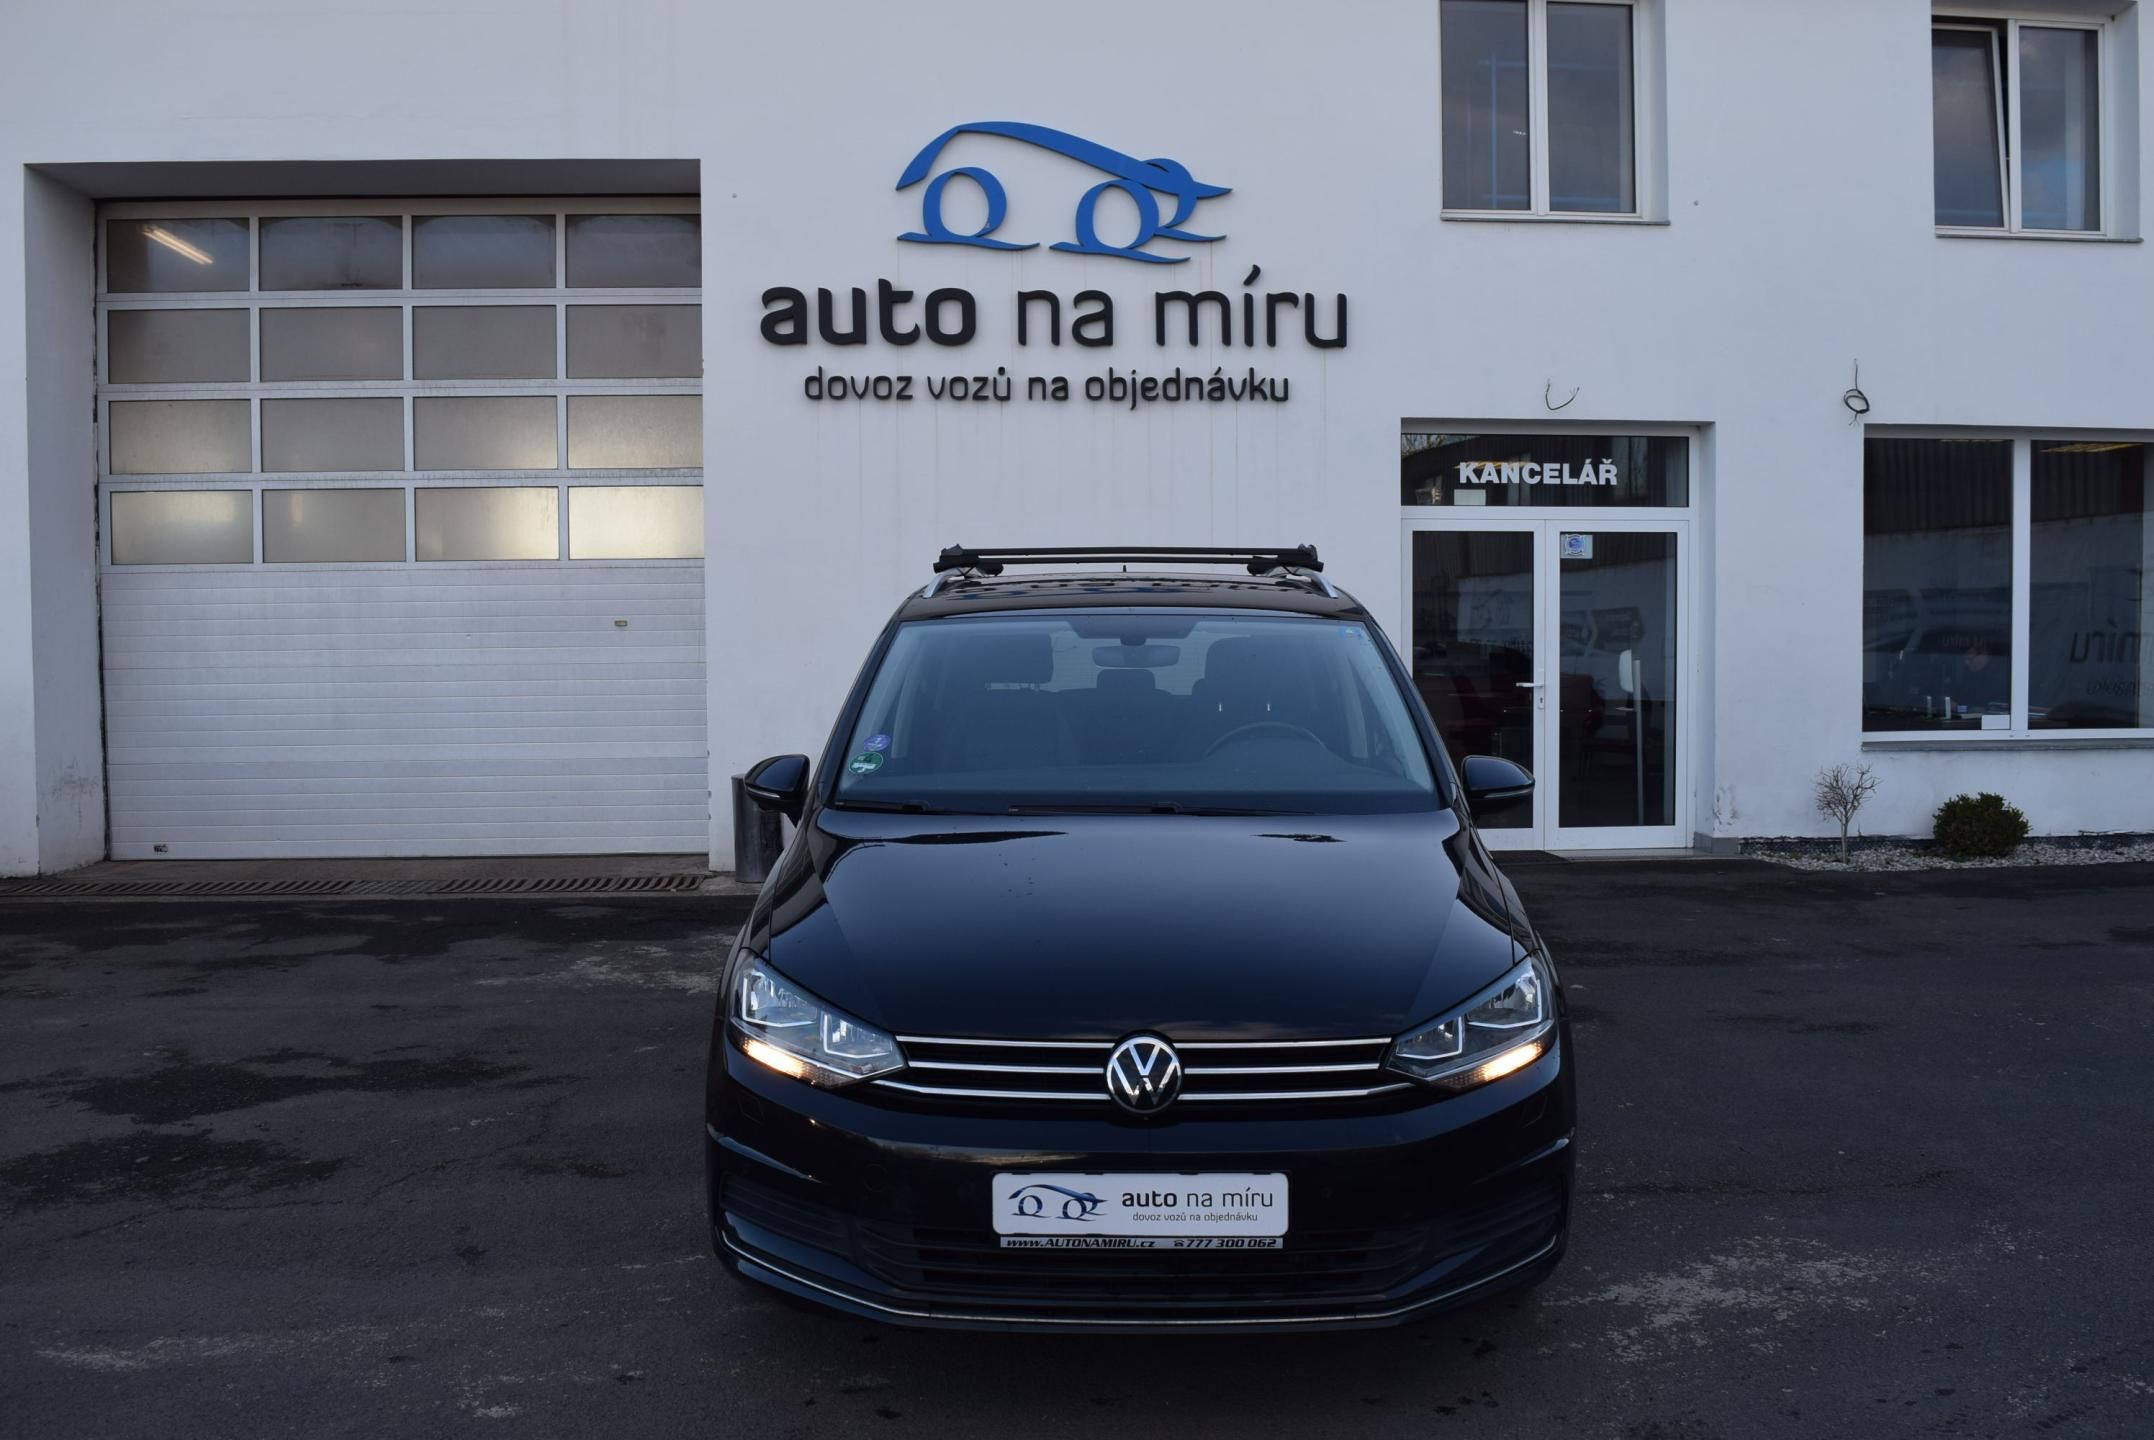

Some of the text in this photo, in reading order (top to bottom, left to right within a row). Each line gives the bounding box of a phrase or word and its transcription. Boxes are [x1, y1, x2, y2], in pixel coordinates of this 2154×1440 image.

[760, 264, 1347, 348] auto na míru
[804, 366, 1289, 410] dovoz vozů na objednávku
[1459, 458, 1618, 485] KANCELÁŘ
[1121, 1187, 1273, 1207] auto na míru
[1132, 1211, 1258, 1223] dovoz vozů na objednávku
[1007, 1238, 1155, 1248] www.AUTONAMIRU.cz
[1186, 1238, 1277, 1248] 777 300 062
